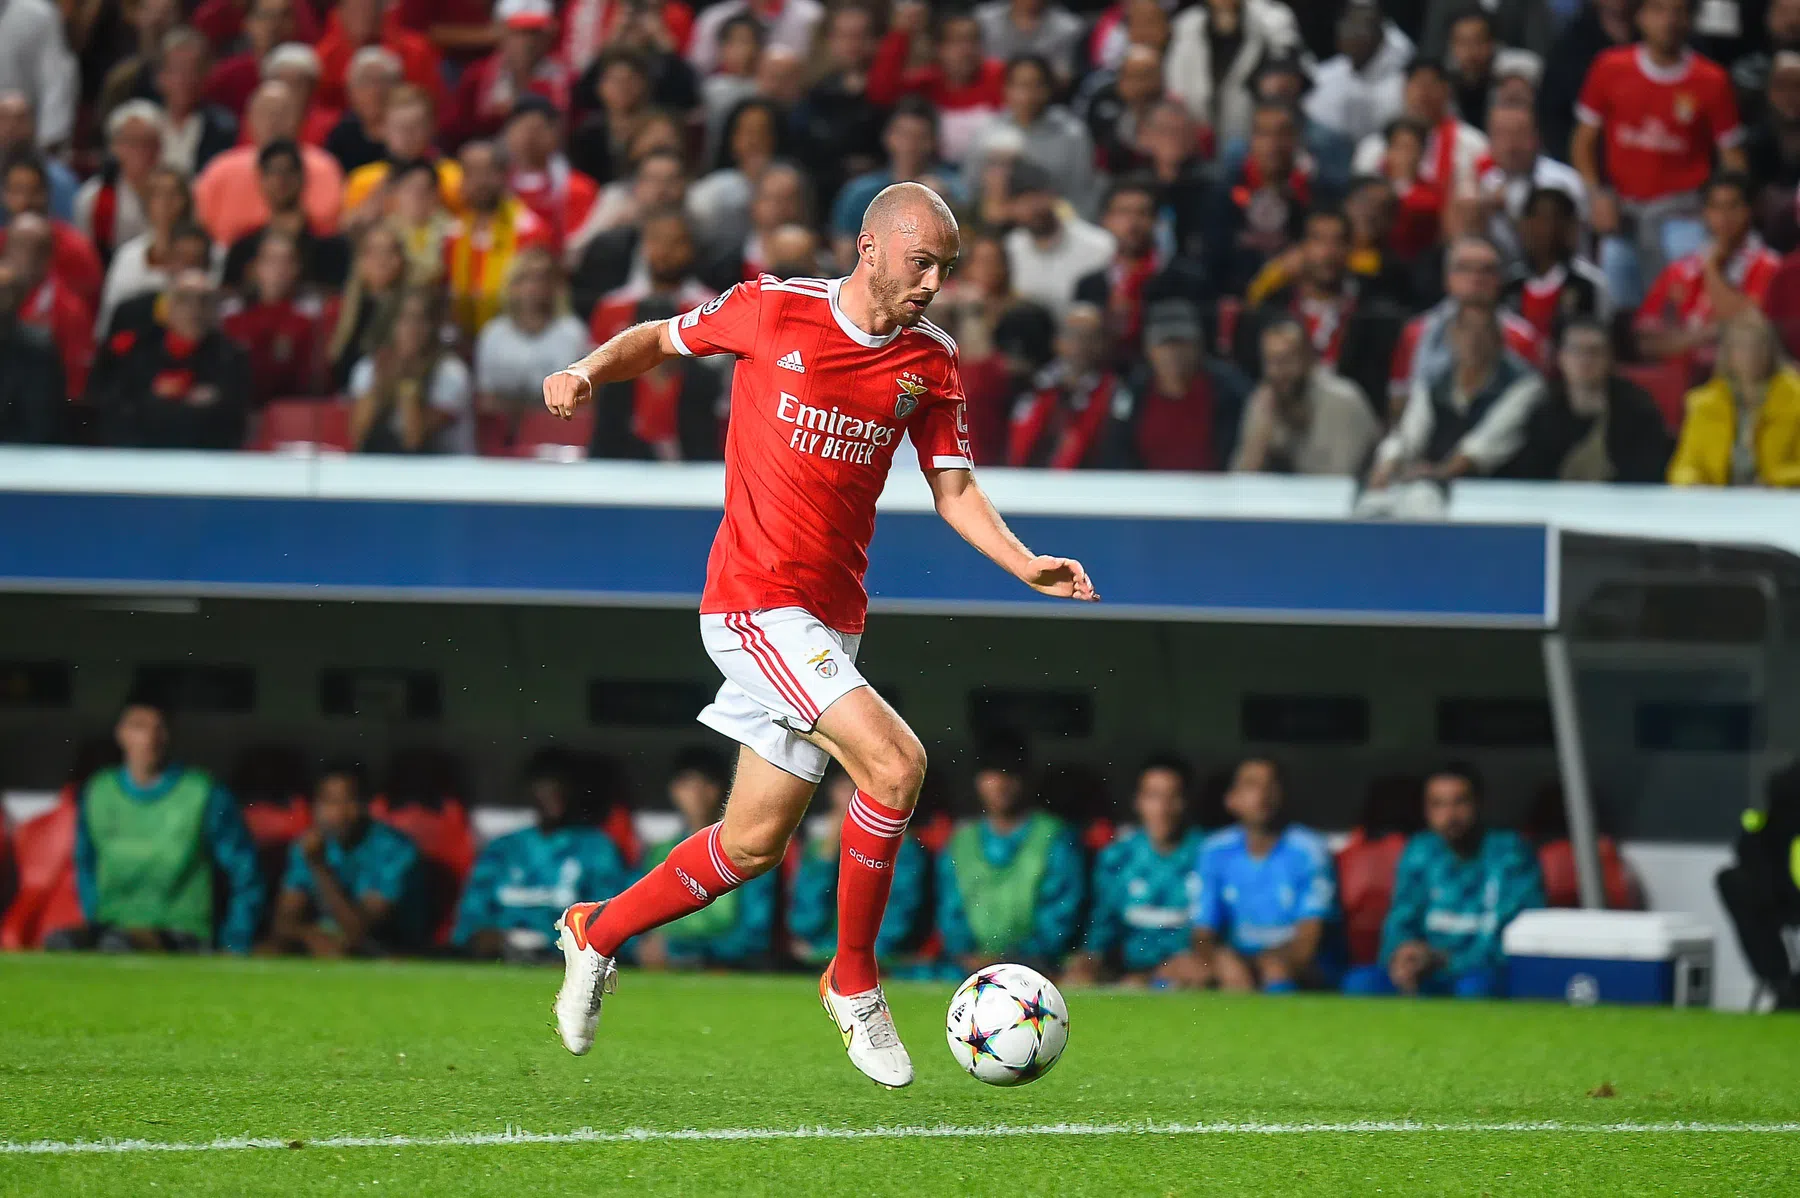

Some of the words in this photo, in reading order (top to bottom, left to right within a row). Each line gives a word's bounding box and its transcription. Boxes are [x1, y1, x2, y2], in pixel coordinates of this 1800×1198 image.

[776, 360, 806, 374] adidas
[776, 391, 895, 446] Emirates
[789, 428, 821, 455] FLY
[821, 436, 876, 465] BETTER
[849, 847, 890, 869] adidas
